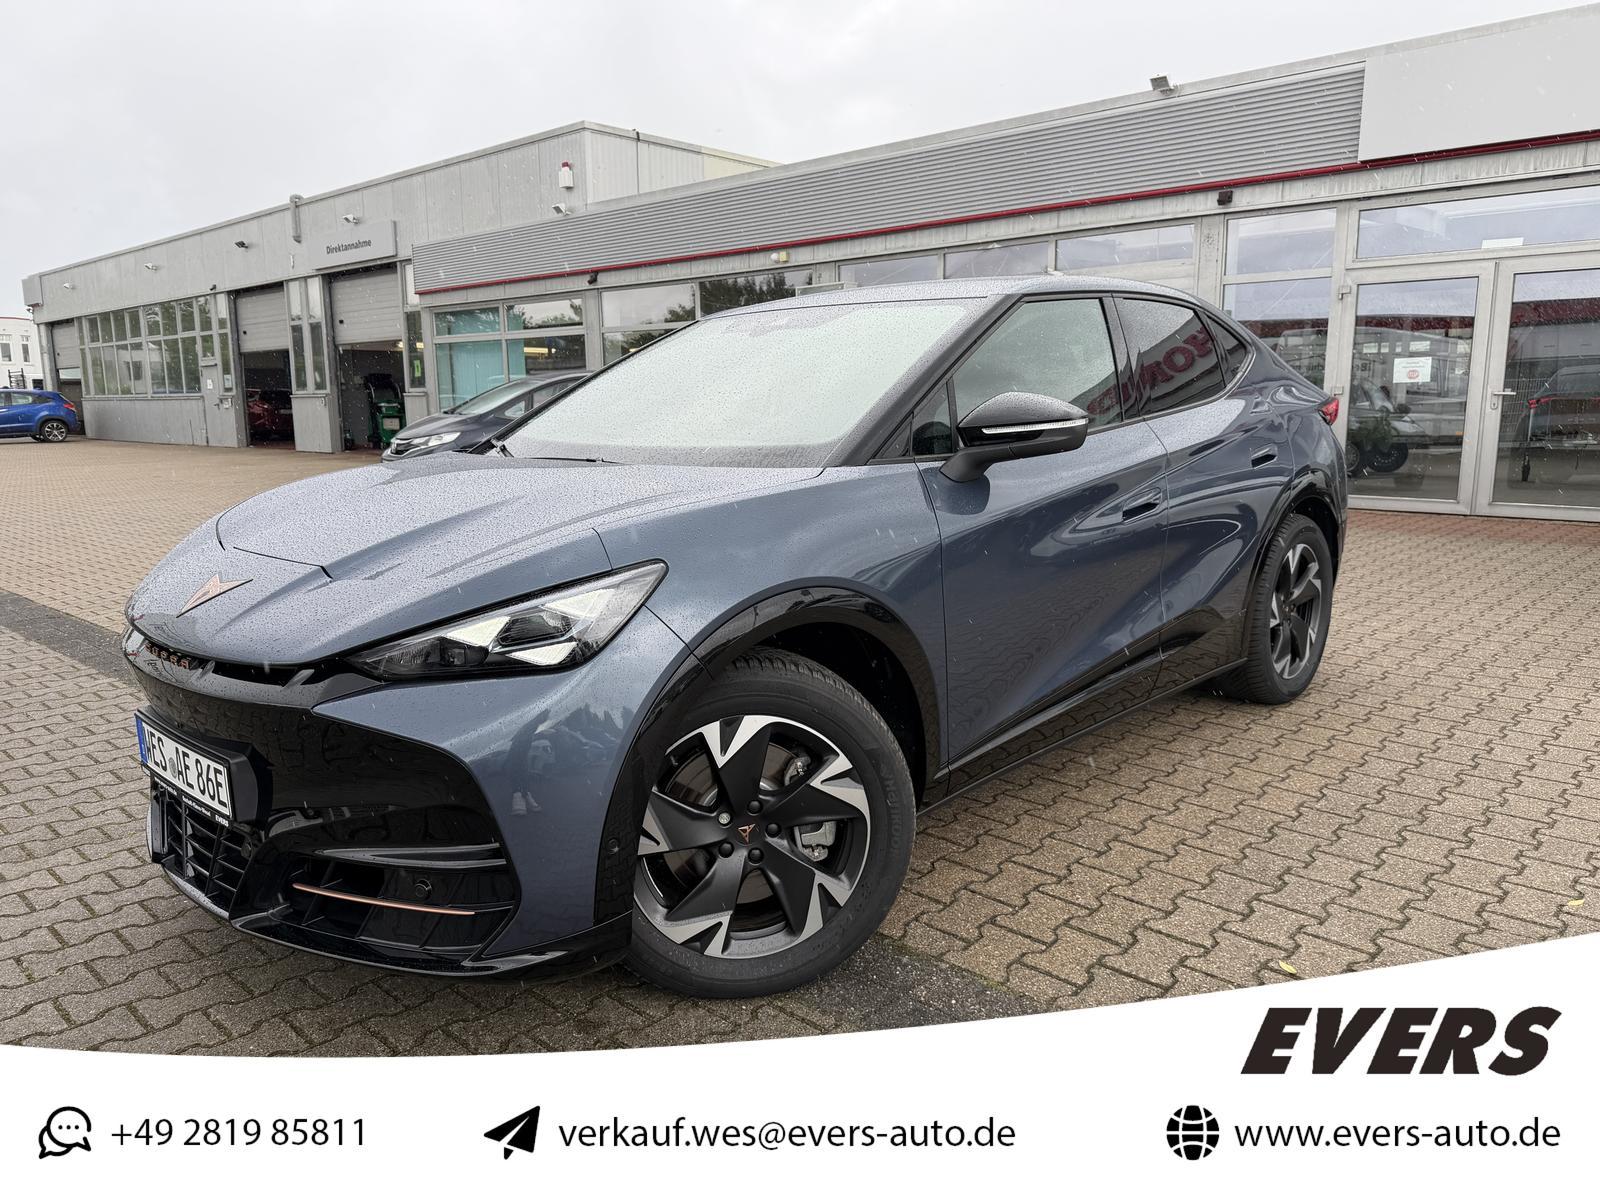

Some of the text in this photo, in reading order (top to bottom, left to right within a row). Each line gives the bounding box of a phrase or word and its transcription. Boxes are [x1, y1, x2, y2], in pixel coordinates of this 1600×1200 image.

[326, 239, 372, 255] Direktannahme
[175, 746, 195, 791] AE
[195, 757, 229, 809] 86E
